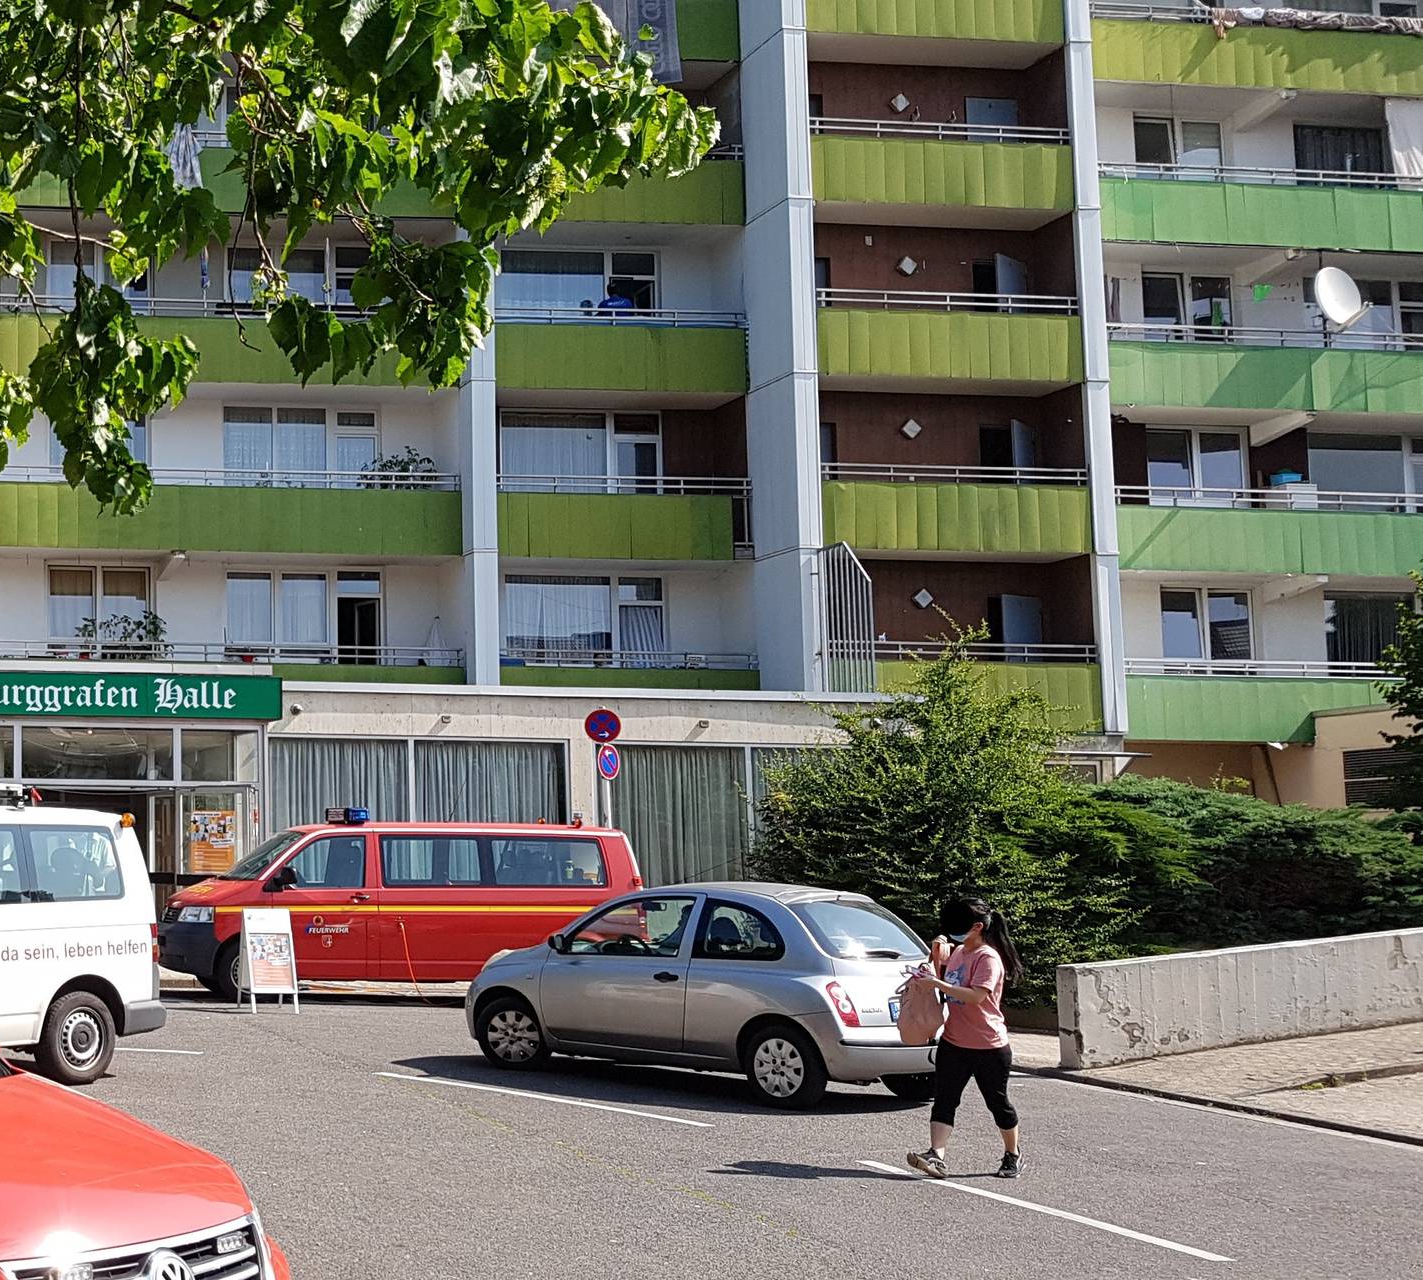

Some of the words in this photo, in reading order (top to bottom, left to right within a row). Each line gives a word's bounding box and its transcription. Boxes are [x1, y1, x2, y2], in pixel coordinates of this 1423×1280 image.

[153, 678, 237, 714] Halle
[1, 946, 19, 962] da
[24, 944, 60, 961] sein,
[64, 942, 103, 958] leben
[107, 939, 148, 956] helfen
